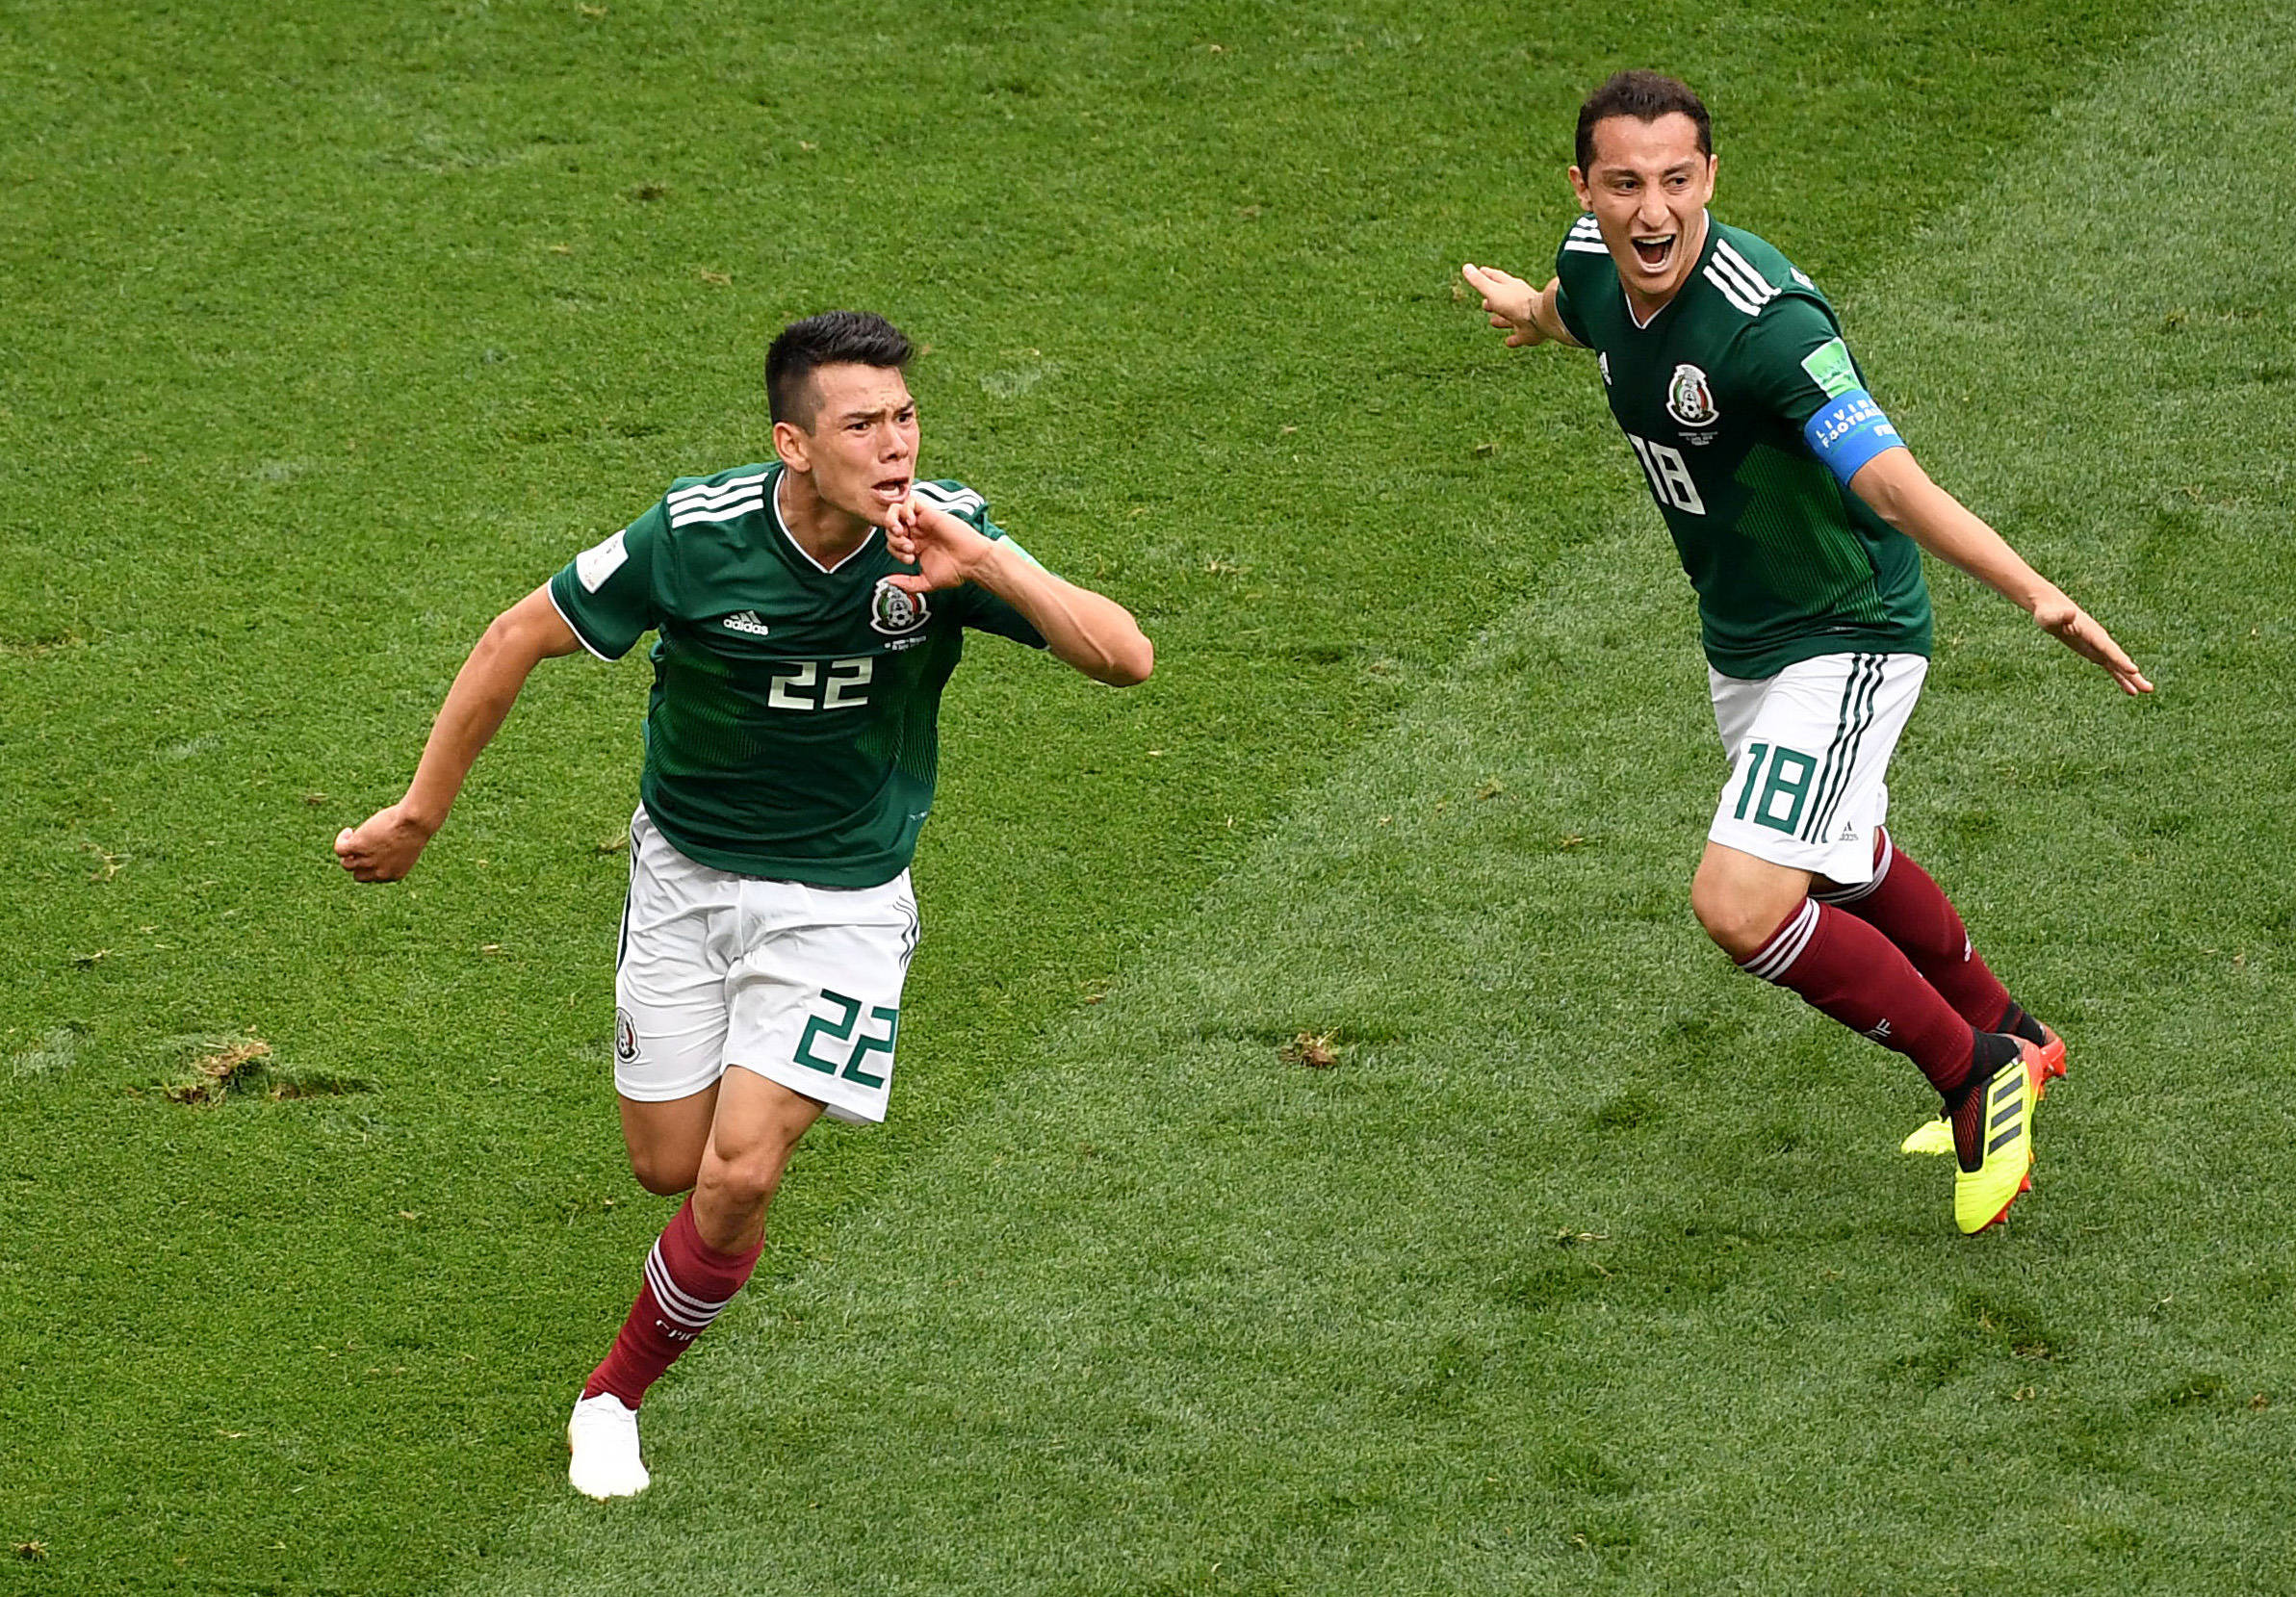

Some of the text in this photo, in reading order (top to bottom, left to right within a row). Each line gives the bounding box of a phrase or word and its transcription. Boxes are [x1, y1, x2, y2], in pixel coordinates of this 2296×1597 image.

[1627, 432, 1706, 515] 18
[723, 618, 769, 636] adidas
[768, 657, 873, 710] 22
[1734, 742, 1818, 836] 18
[792, 988, 899, 1090] 22
